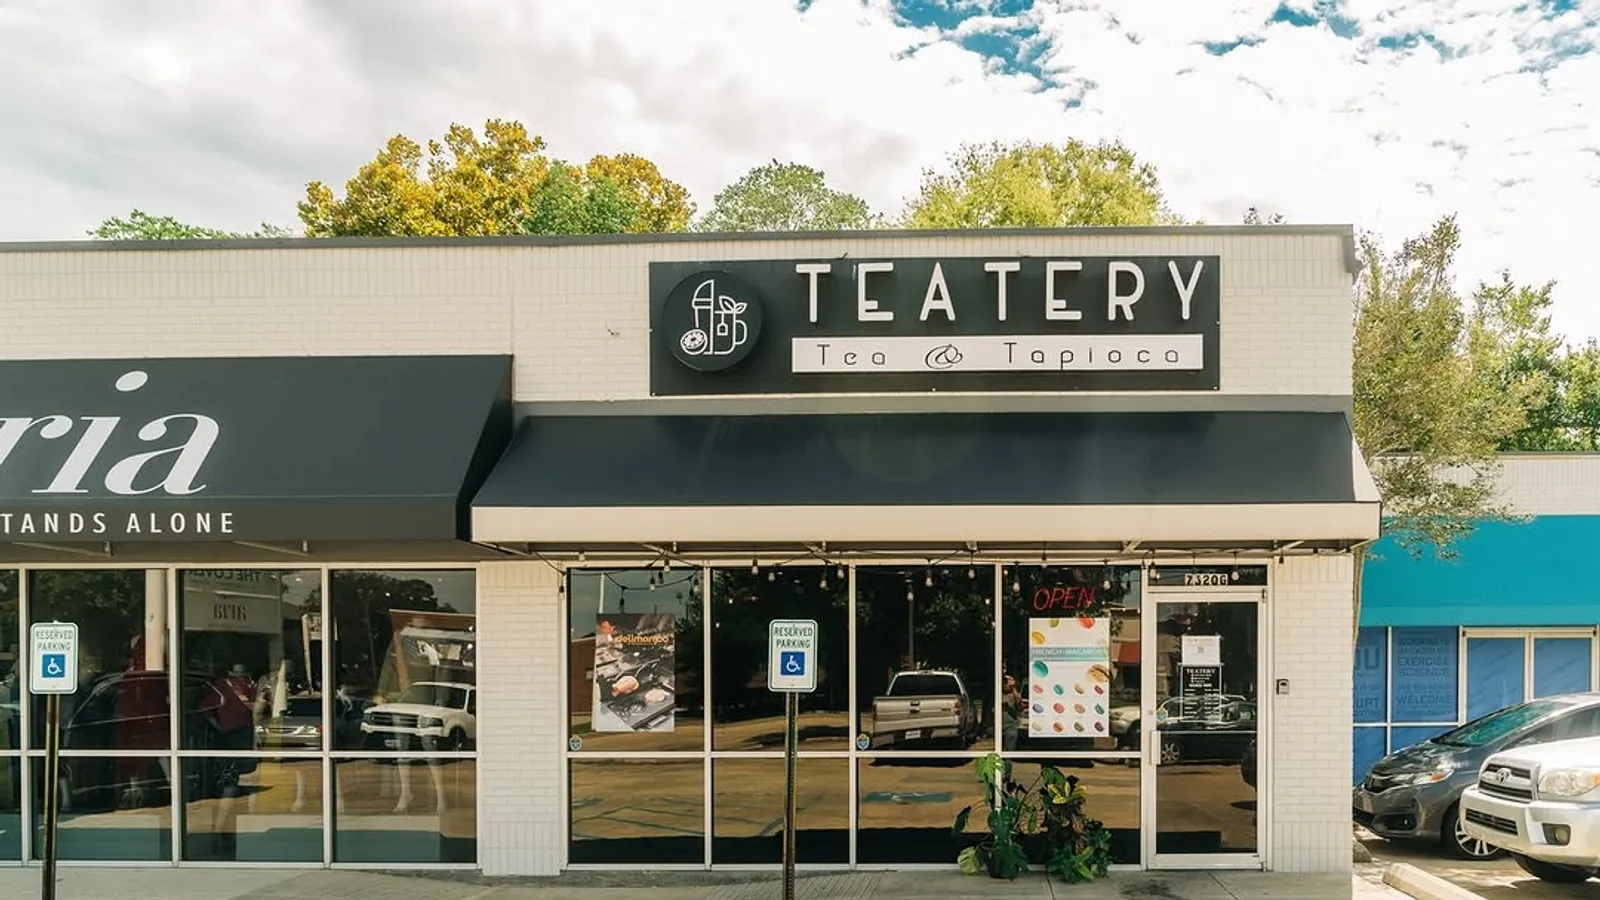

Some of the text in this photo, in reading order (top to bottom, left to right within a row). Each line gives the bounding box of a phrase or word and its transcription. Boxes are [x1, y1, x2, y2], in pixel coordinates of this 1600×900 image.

[796, 261, 1204, 323] TEATERY
[817, 344, 886, 366] Tea
[1004, 342, 1179, 371] Tapioca
[0, 512, 233, 534] TANDS ALONE
[1033, 586, 1096, 611] OPEN
[35, 629, 74, 640] RESERVED
[774, 626, 813, 637] RESERVED
[37, 641, 71, 651] PARKING
[776, 638, 811, 649] PARKING
[1397, 656, 1452, 667] EXERCISE
[1397, 667, 1453, 677] SCIENCE
[1396, 694, 1453, 704] WELCOME
